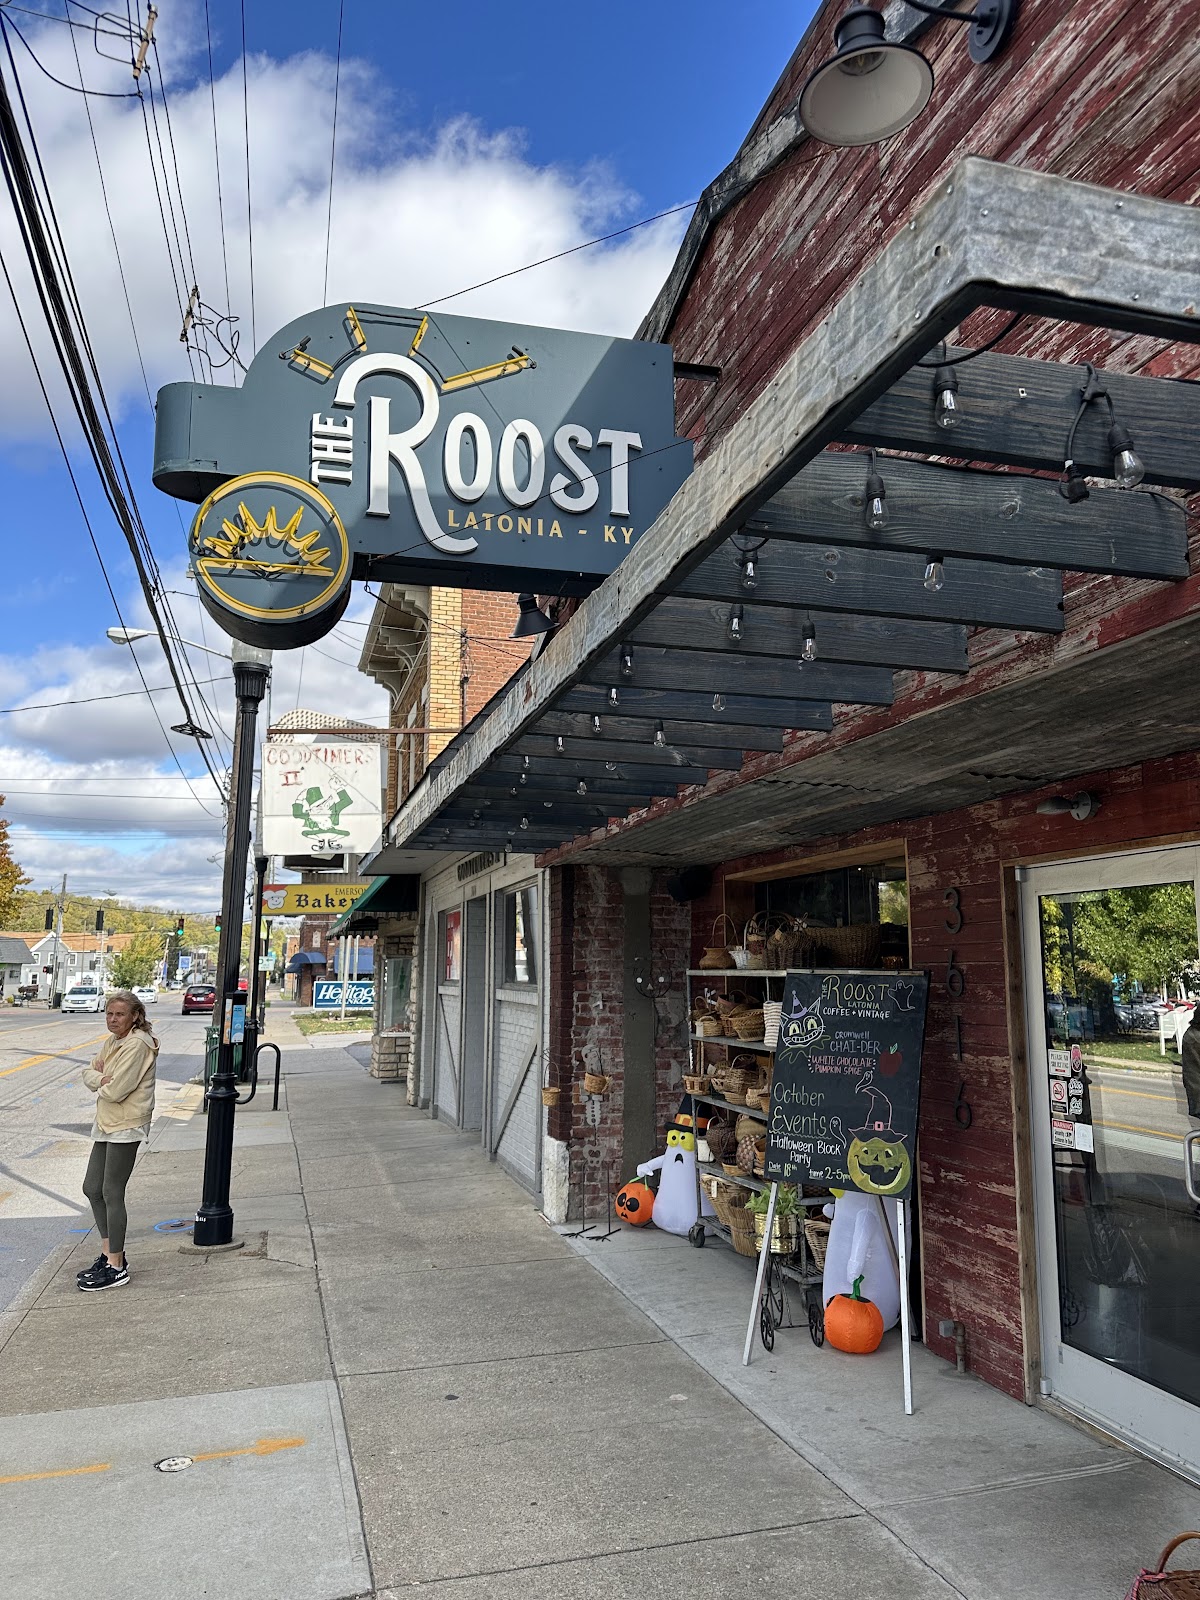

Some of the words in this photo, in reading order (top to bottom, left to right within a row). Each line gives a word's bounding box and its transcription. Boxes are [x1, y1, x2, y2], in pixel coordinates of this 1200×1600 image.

[312, 411, 354, 486] THE
[333, 352, 644, 555] ROOST
[448, 508, 566, 539] LATONIA
[604, 524, 635, 545] KY
[317, 984, 375, 1004] Heitag
[823, 974, 890, 1009] ROOST
[823, 1007, 851, 1016] COFFEE
[858, 1009, 891, 1020] VINTAGE
[847, 1001, 880, 1010] LATONIA
[830, 1040, 881, 1055] CHAI-DER
[811, 1055, 835, 1065] WHITE
[836, 1056, 873, 1067] CHOCOLATE
[815, 1064, 841, 1074] PUMPKIN
[843, 1066, 863, 1076] SPICE
[773, 1082, 825, 1107] October
[772, 1105, 827, 1136] Events
[1053, 1120, 1073, 1130] WARNING
[770, 1134, 814, 1154] Halloween
[817, 1140, 842, 1156] Block
[768, 1161, 781, 1169] Date
[790, 1151, 811, 1168] Party
[809, 1168, 824, 1178] time
